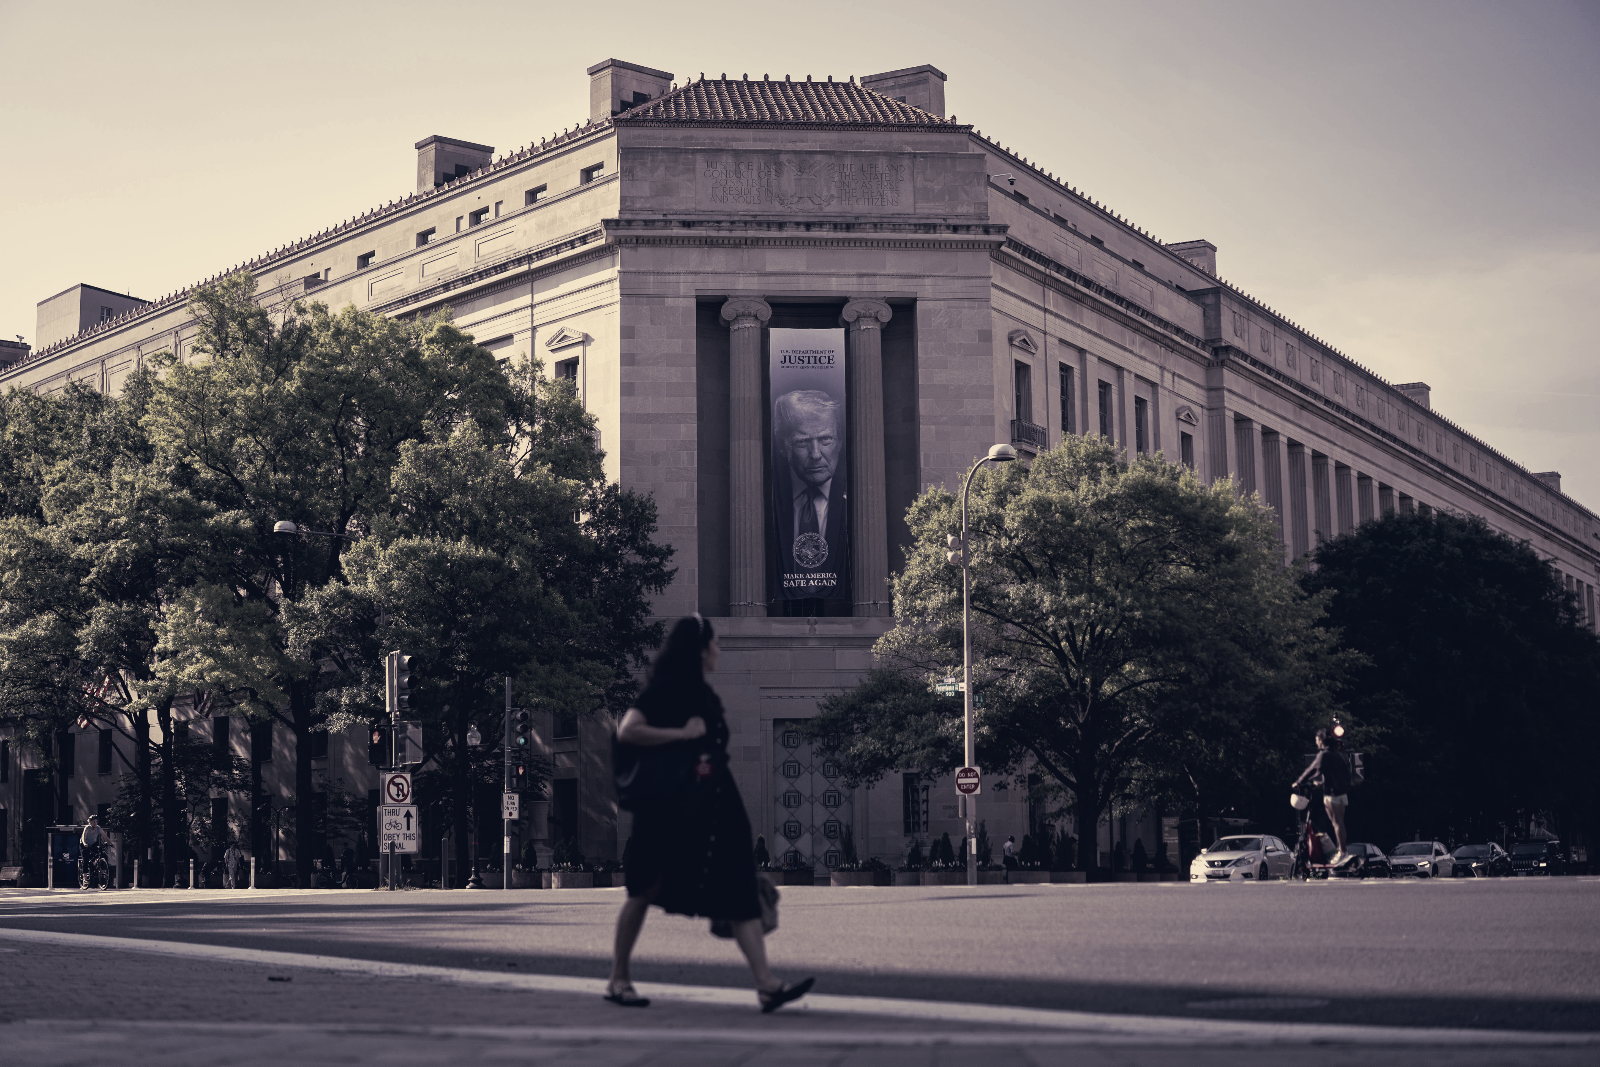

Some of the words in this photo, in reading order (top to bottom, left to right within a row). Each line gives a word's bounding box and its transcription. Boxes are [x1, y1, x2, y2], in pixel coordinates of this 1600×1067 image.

[706, 161, 754, 170] JUSTICE
[759, 162, 772, 171] IN
[838, 163, 855, 172] THE
[861, 163, 881, 173] LIFE
[884, 164, 906, 173] AND
[703, 169, 753, 178] CONDUCT
[758, 170, 772, 179] OF
[838, 172, 858, 181] THE
[862, 172, 891, 182] STATE
[835, 180, 859, 189] ONLY
[861, 180, 873, 189] AS
[764, 187, 774, 197] IN
[838, 188, 858, 198] THE
[862, 189, 900, 198] HEARTS
[710, 195, 729, 204] AND
[731, 195, 762, 205] SOULS
[855, 197, 900, 207] CITIZENS
[780, 355, 835, 365] JUSTICE
[783, 579, 807, 588] SAFE
[808, 579, 837, 587] AGAIN
[383, 808, 401, 817] THRU
[383, 833, 401, 841] OBEY
[403, 832, 416, 841] THIS
[383, 842, 406, 850] SINAL
